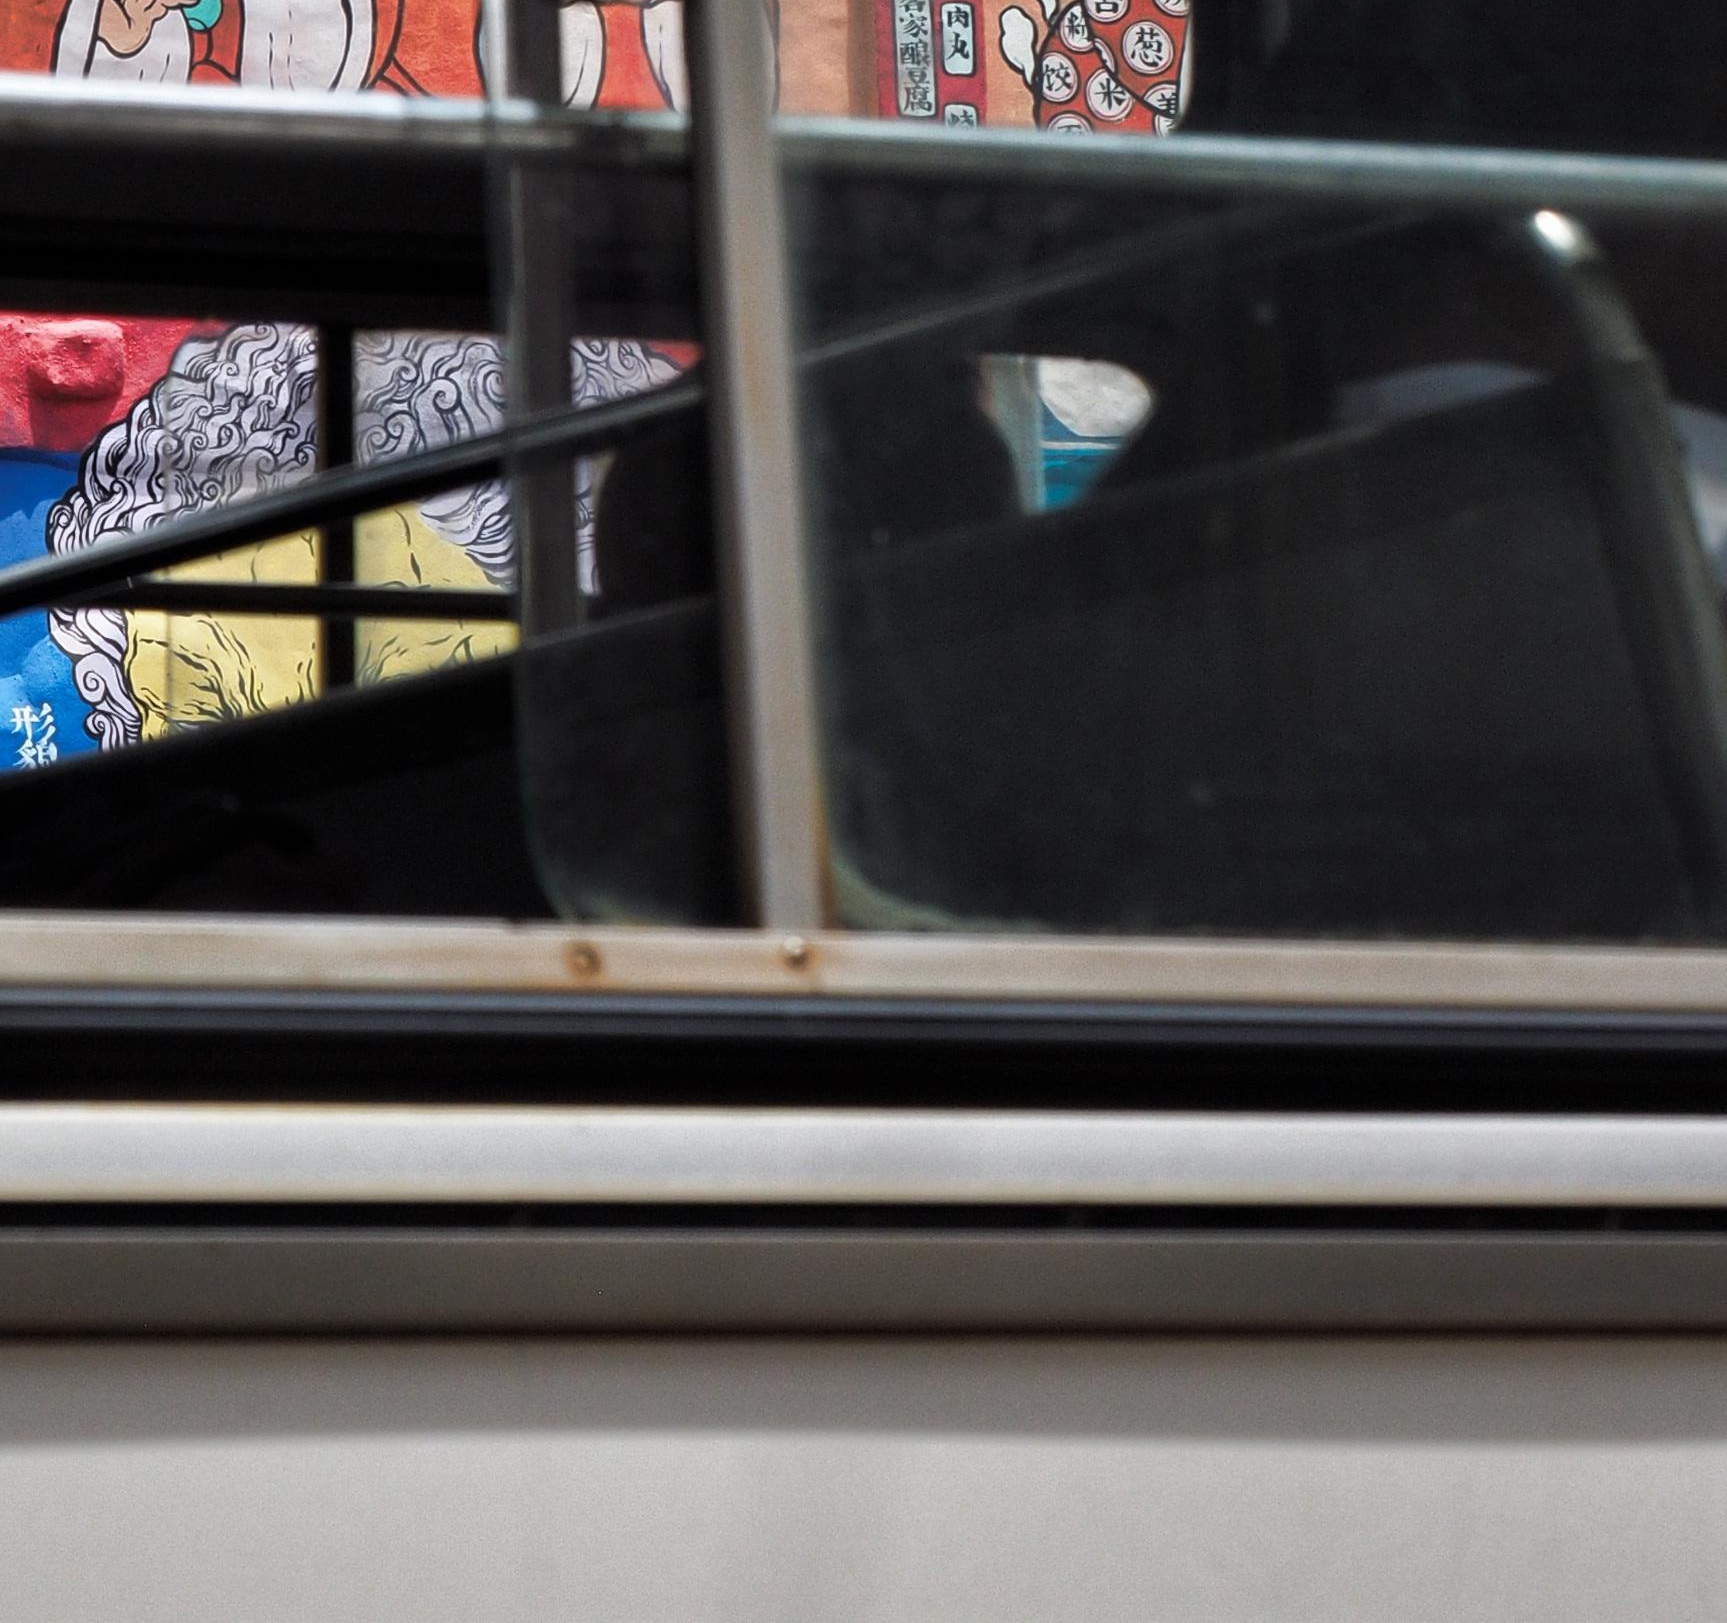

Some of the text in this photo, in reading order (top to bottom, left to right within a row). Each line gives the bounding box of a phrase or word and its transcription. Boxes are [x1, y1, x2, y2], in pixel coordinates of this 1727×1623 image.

[947, 6, 970, 61] 肉丸
[1130, 26, 1164, 67] 葱
[1043, 62, 1072, 92] 饺
[1094, 77, 1126, 111] 米
